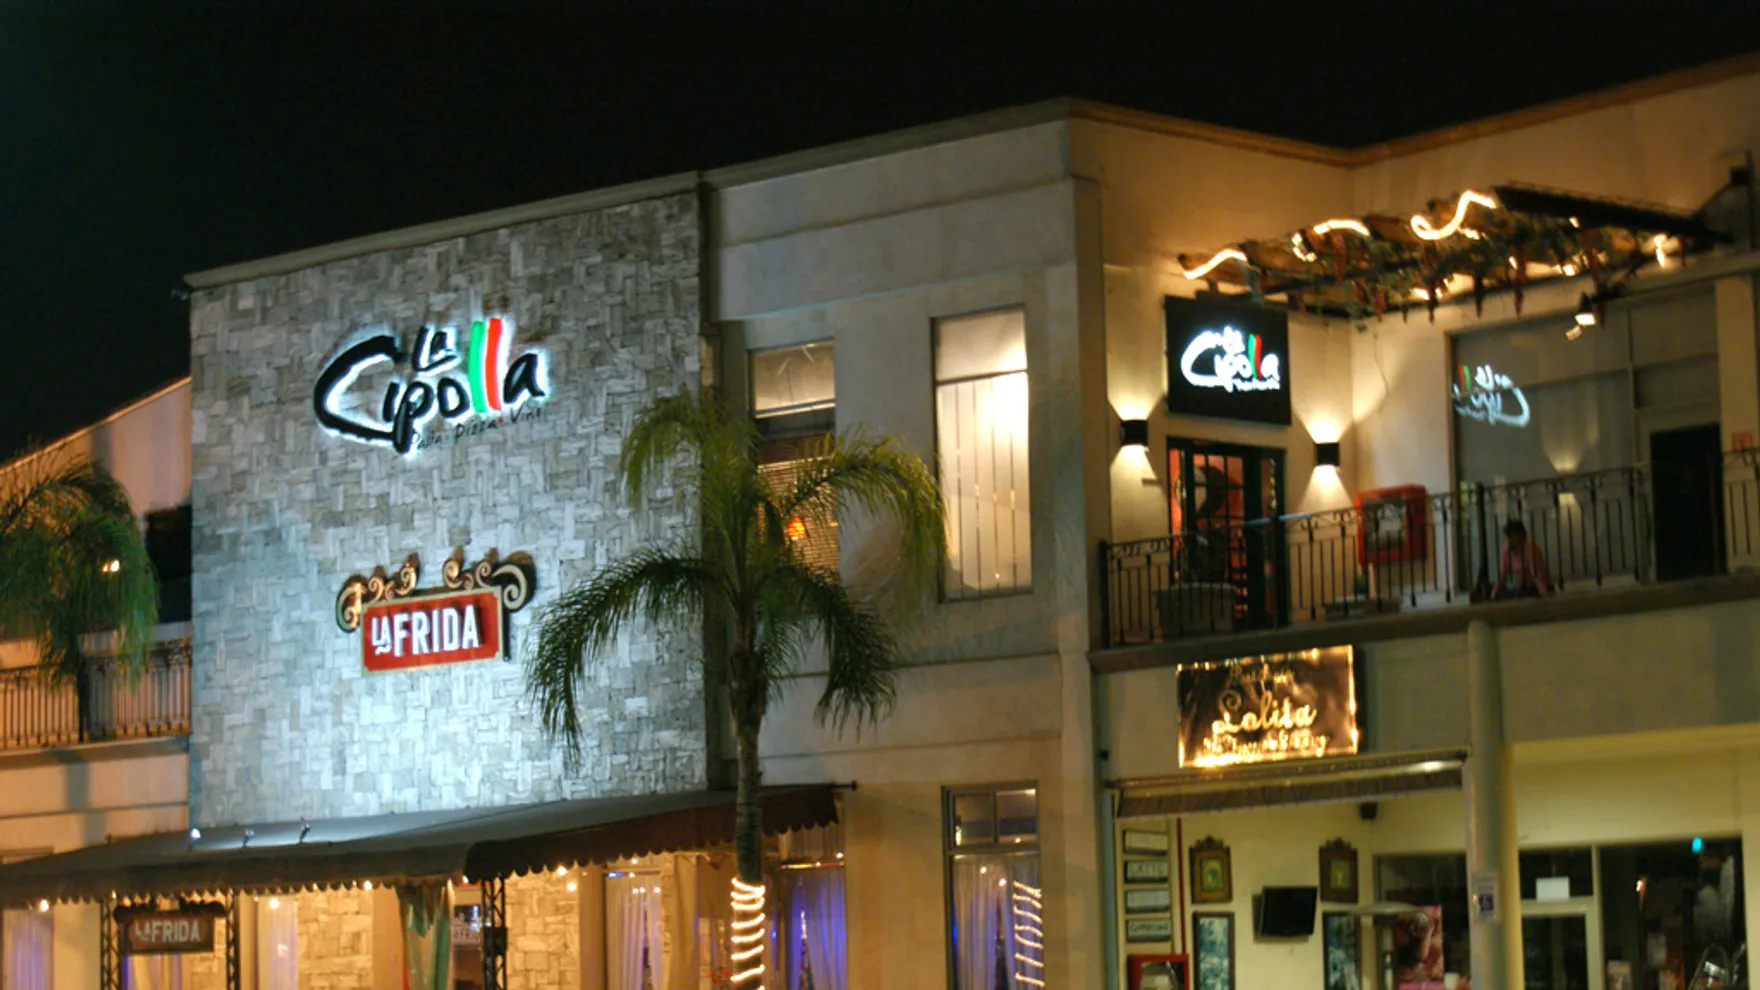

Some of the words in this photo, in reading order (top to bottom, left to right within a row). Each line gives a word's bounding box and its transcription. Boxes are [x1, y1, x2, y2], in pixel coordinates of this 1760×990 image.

[312, 317, 547, 454] Cipolla
[393, 603, 481, 658] FRIDA
[1211, 690, 1318, 733] Lolita
[151, 919, 201, 944] FRIDA
